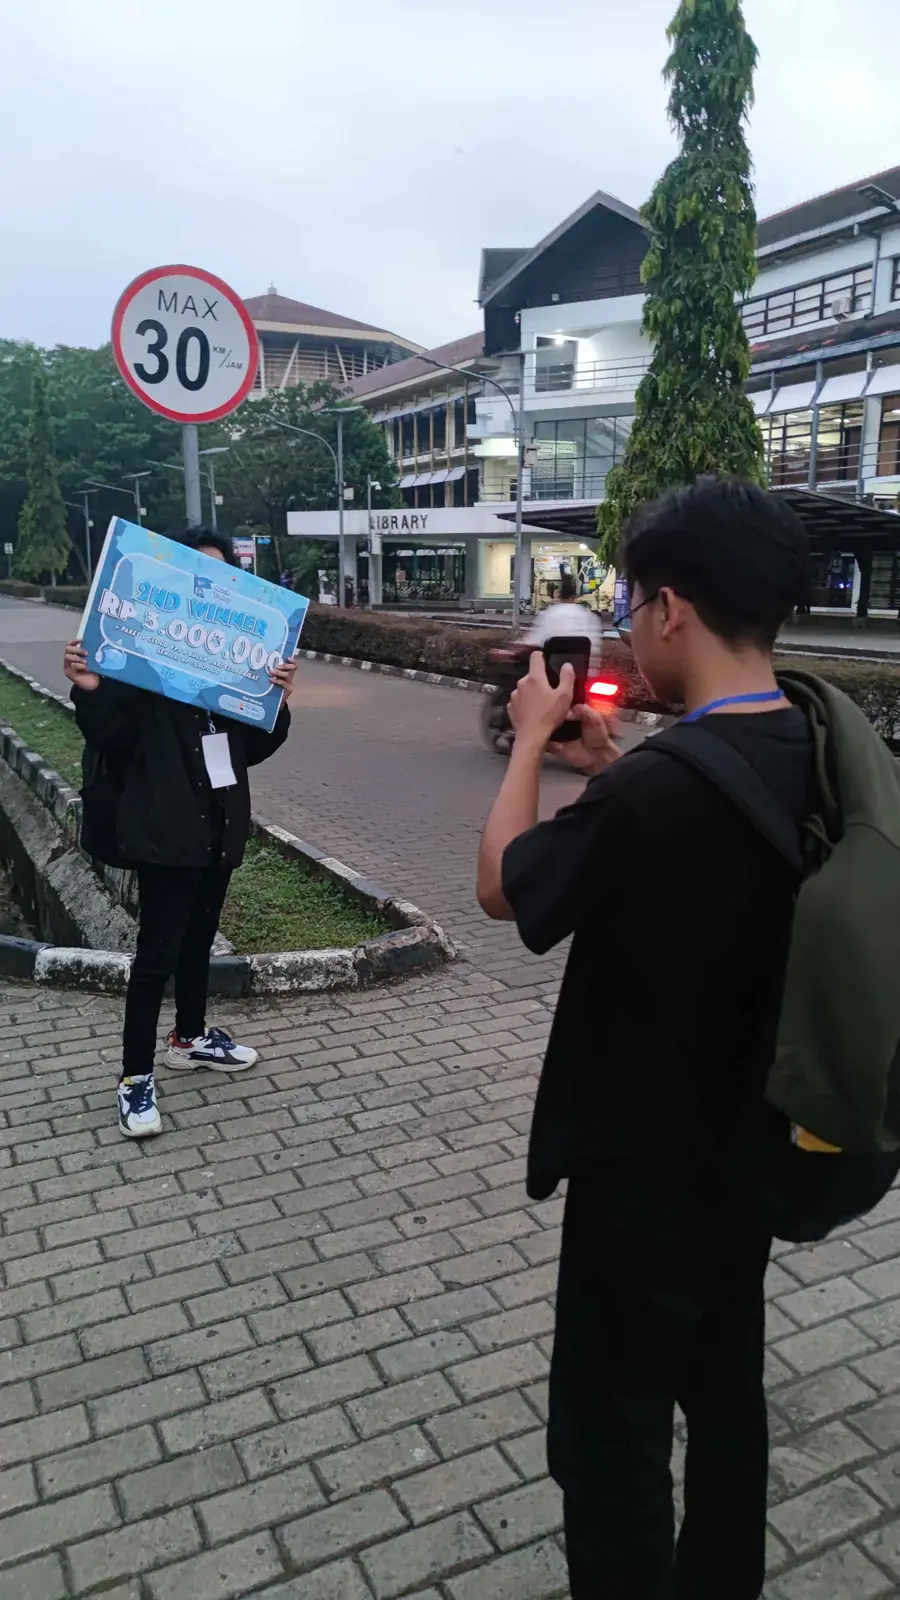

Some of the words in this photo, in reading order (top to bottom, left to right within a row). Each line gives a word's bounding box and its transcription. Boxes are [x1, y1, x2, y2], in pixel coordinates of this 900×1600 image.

[158, 289, 219, 321] MAX
[133, 318, 211, 392] 30
[98, 588, 138, 621] RP
[134, 580, 181, 613] 2ND
[187, 597, 268, 638] WINNER
[120, 625, 141, 637] PAKET
[147, 636, 169, 648] CLOUD
